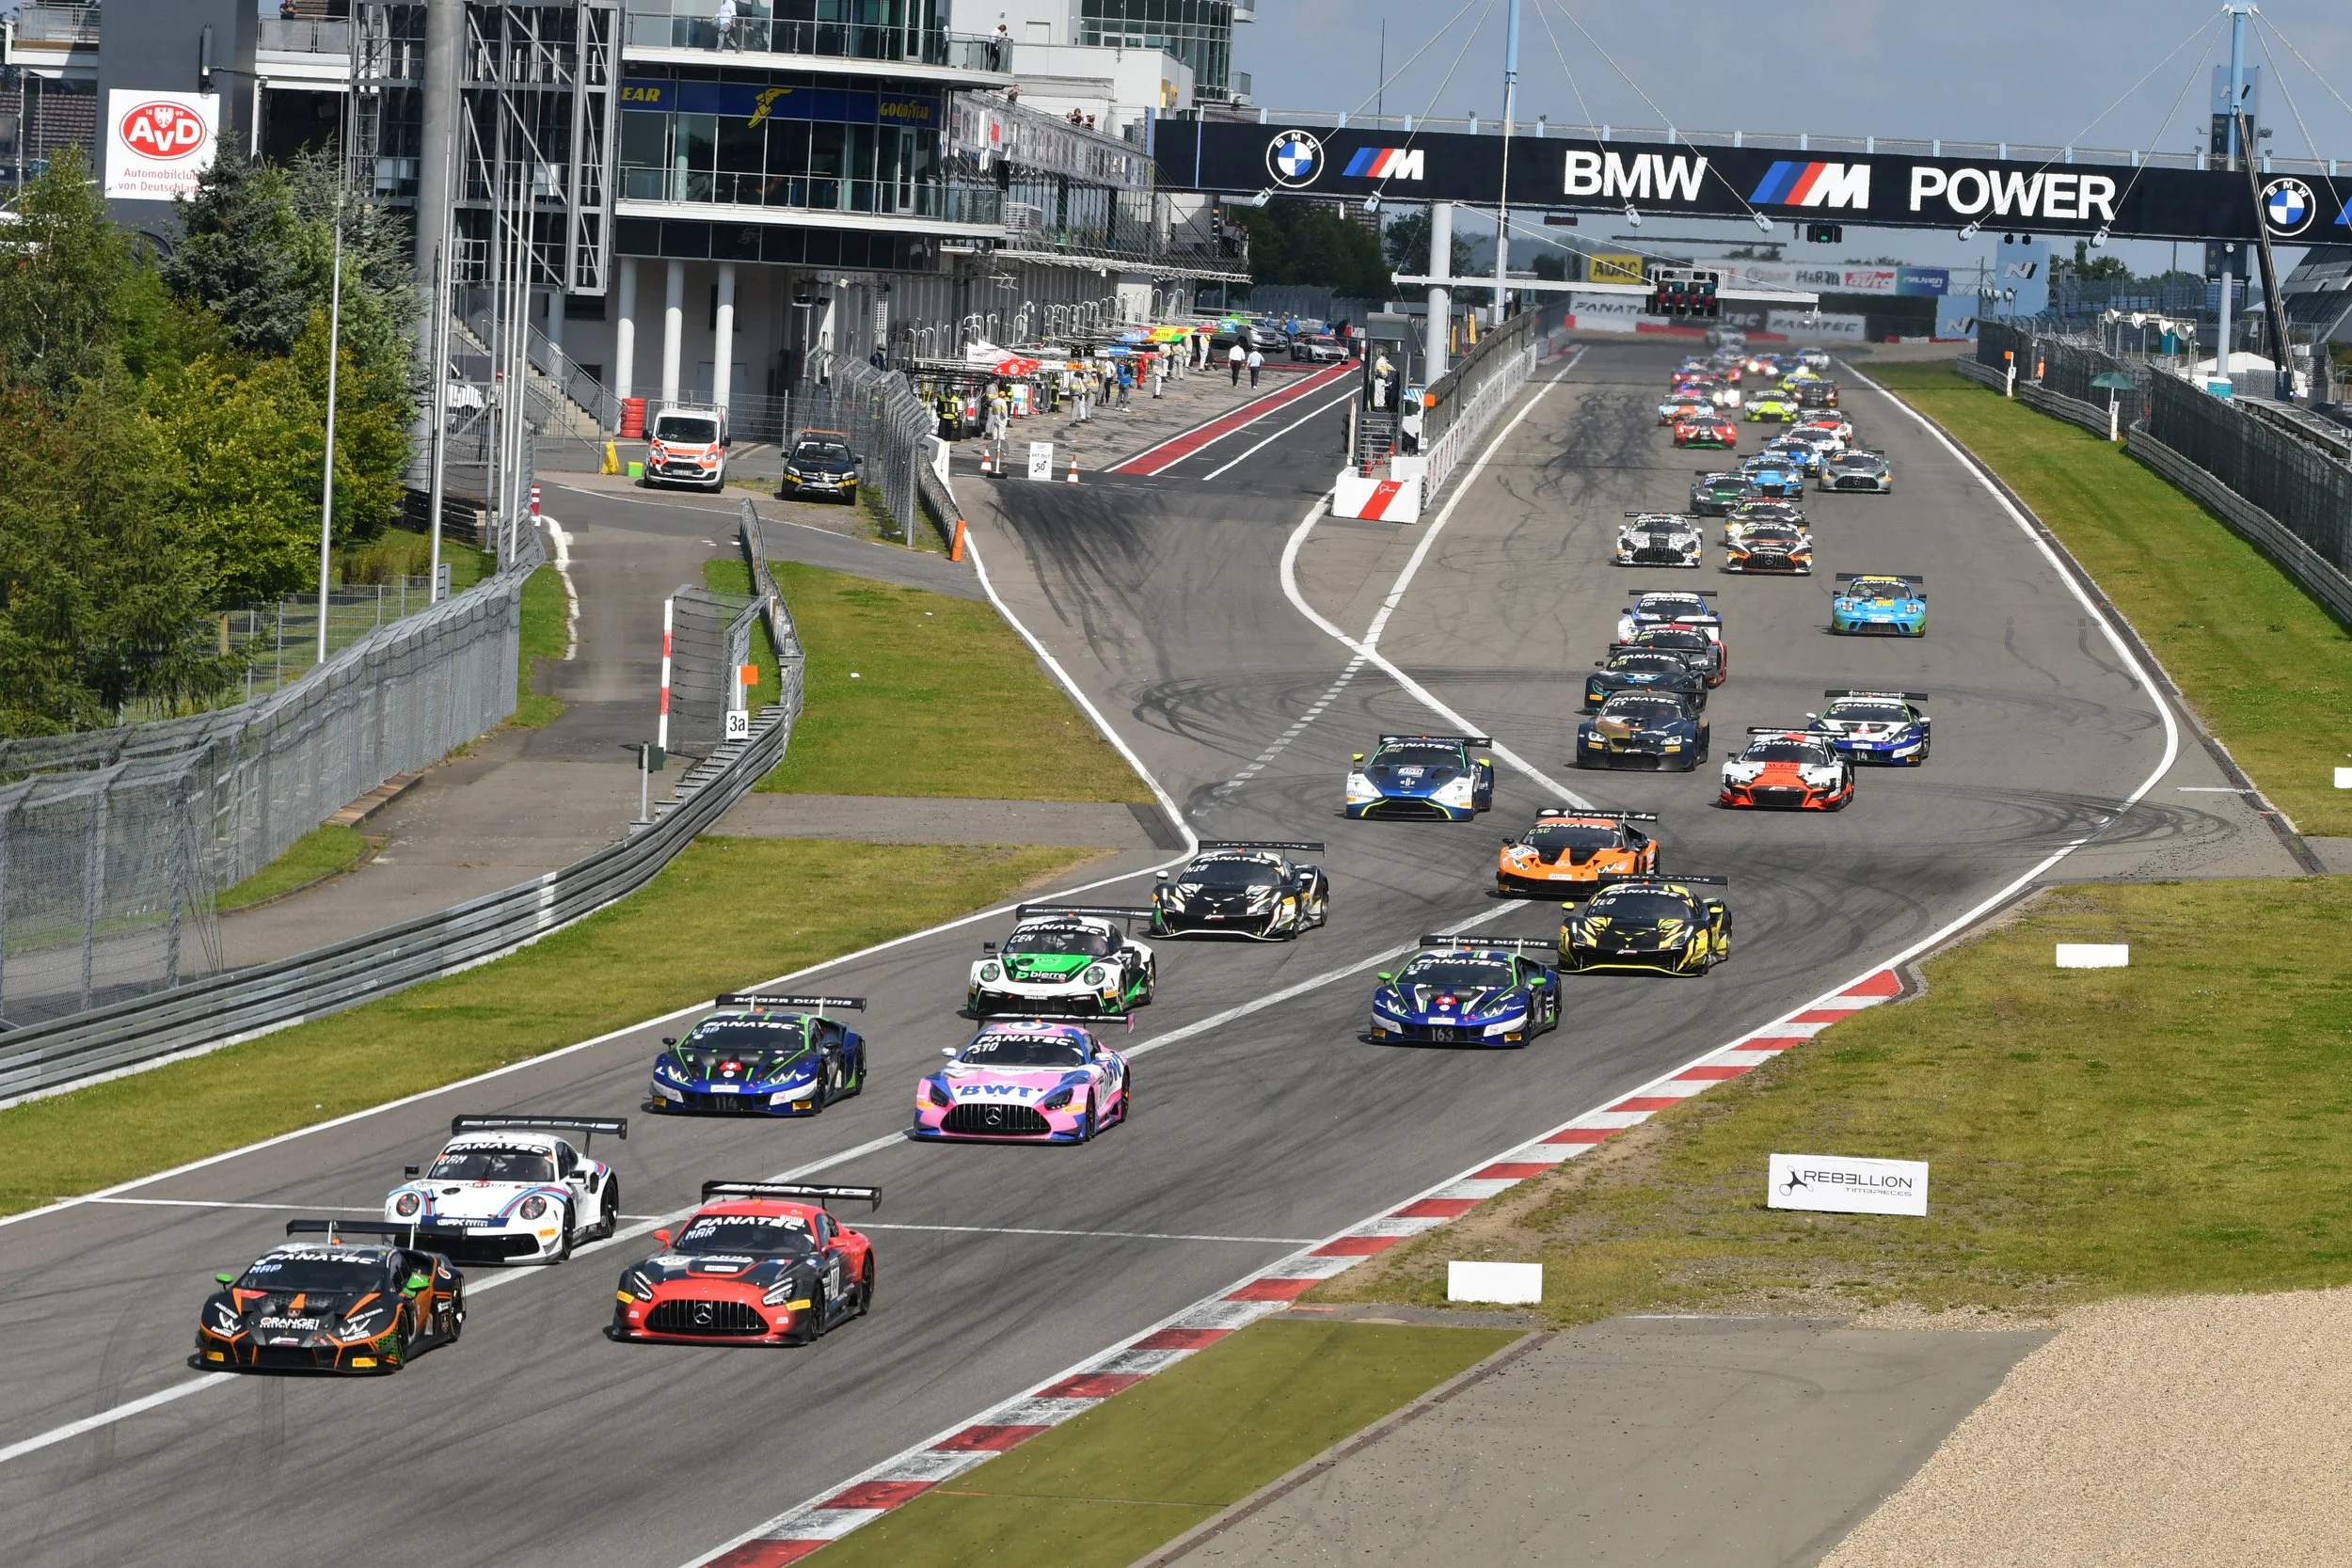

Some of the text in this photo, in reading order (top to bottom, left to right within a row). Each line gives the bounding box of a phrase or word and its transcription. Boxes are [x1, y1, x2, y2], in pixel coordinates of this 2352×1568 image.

[880, 102, 930, 120] GOODYEAR
[1275, 133, 1317, 150] BMW
[1564, 150, 1708, 201] BMW
[1909, 166, 2117, 221] POWER
[2266, 181, 2310, 198] BMW
[1594, 261, 1638, 279] ADAC
[1618, 654, 1679, 662] FANATEC
[729, 715, 746, 733] 3a
[1754, 740, 1821, 750] FANATEC
[1857, 752, 1867, 761] 14
[1186, 864, 1209, 874] NIE
[1017, 925, 1104, 935] FANATEC
[1010, 935, 1035, 943] CEN
[1417, 958, 1507, 967] FANATEC
[703, 1021, 800, 1031] FANATEC
[1432, 1027, 1454, 1042] 163
[978, 1035, 1073, 1047] FANATEC
[973, 1042, 999, 1054] STO
[960, 1085, 1034, 1098] BWT
[445, 1143, 550, 1154] FANATEC
[438, 1154, 469, 1165] BAM
[1804, 1170, 1913, 1189] REBELLION
[694, 1215, 803, 1231] FANATEC
[685, 1227, 716, 1241] MAR
[264, 1253, 380, 1265] FANATEC
